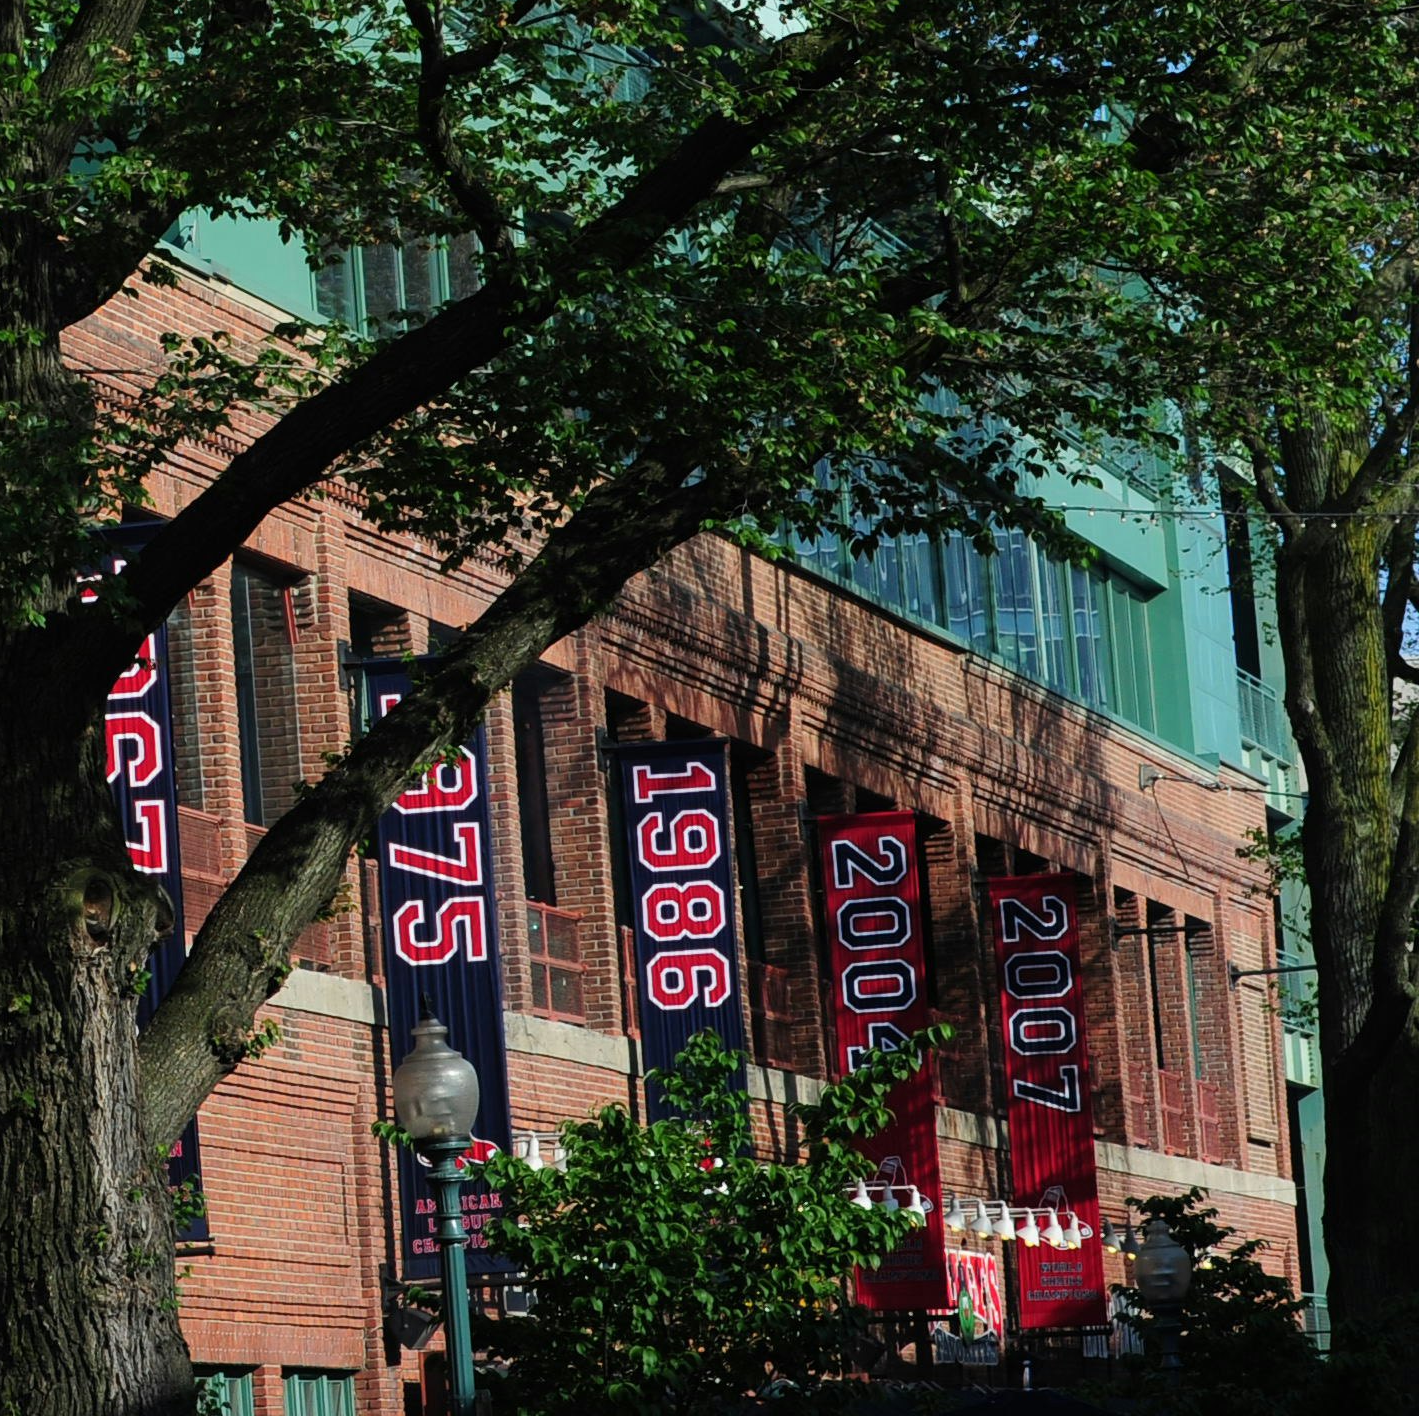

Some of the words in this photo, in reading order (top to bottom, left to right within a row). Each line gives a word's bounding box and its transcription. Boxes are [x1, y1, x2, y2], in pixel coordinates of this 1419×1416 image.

[379, 693, 488, 967] 975
[633, 761, 731, 1010] 1986
[1000, 895, 1082, 1113] 2007
[415, 1193, 503, 1214] AMICAN
